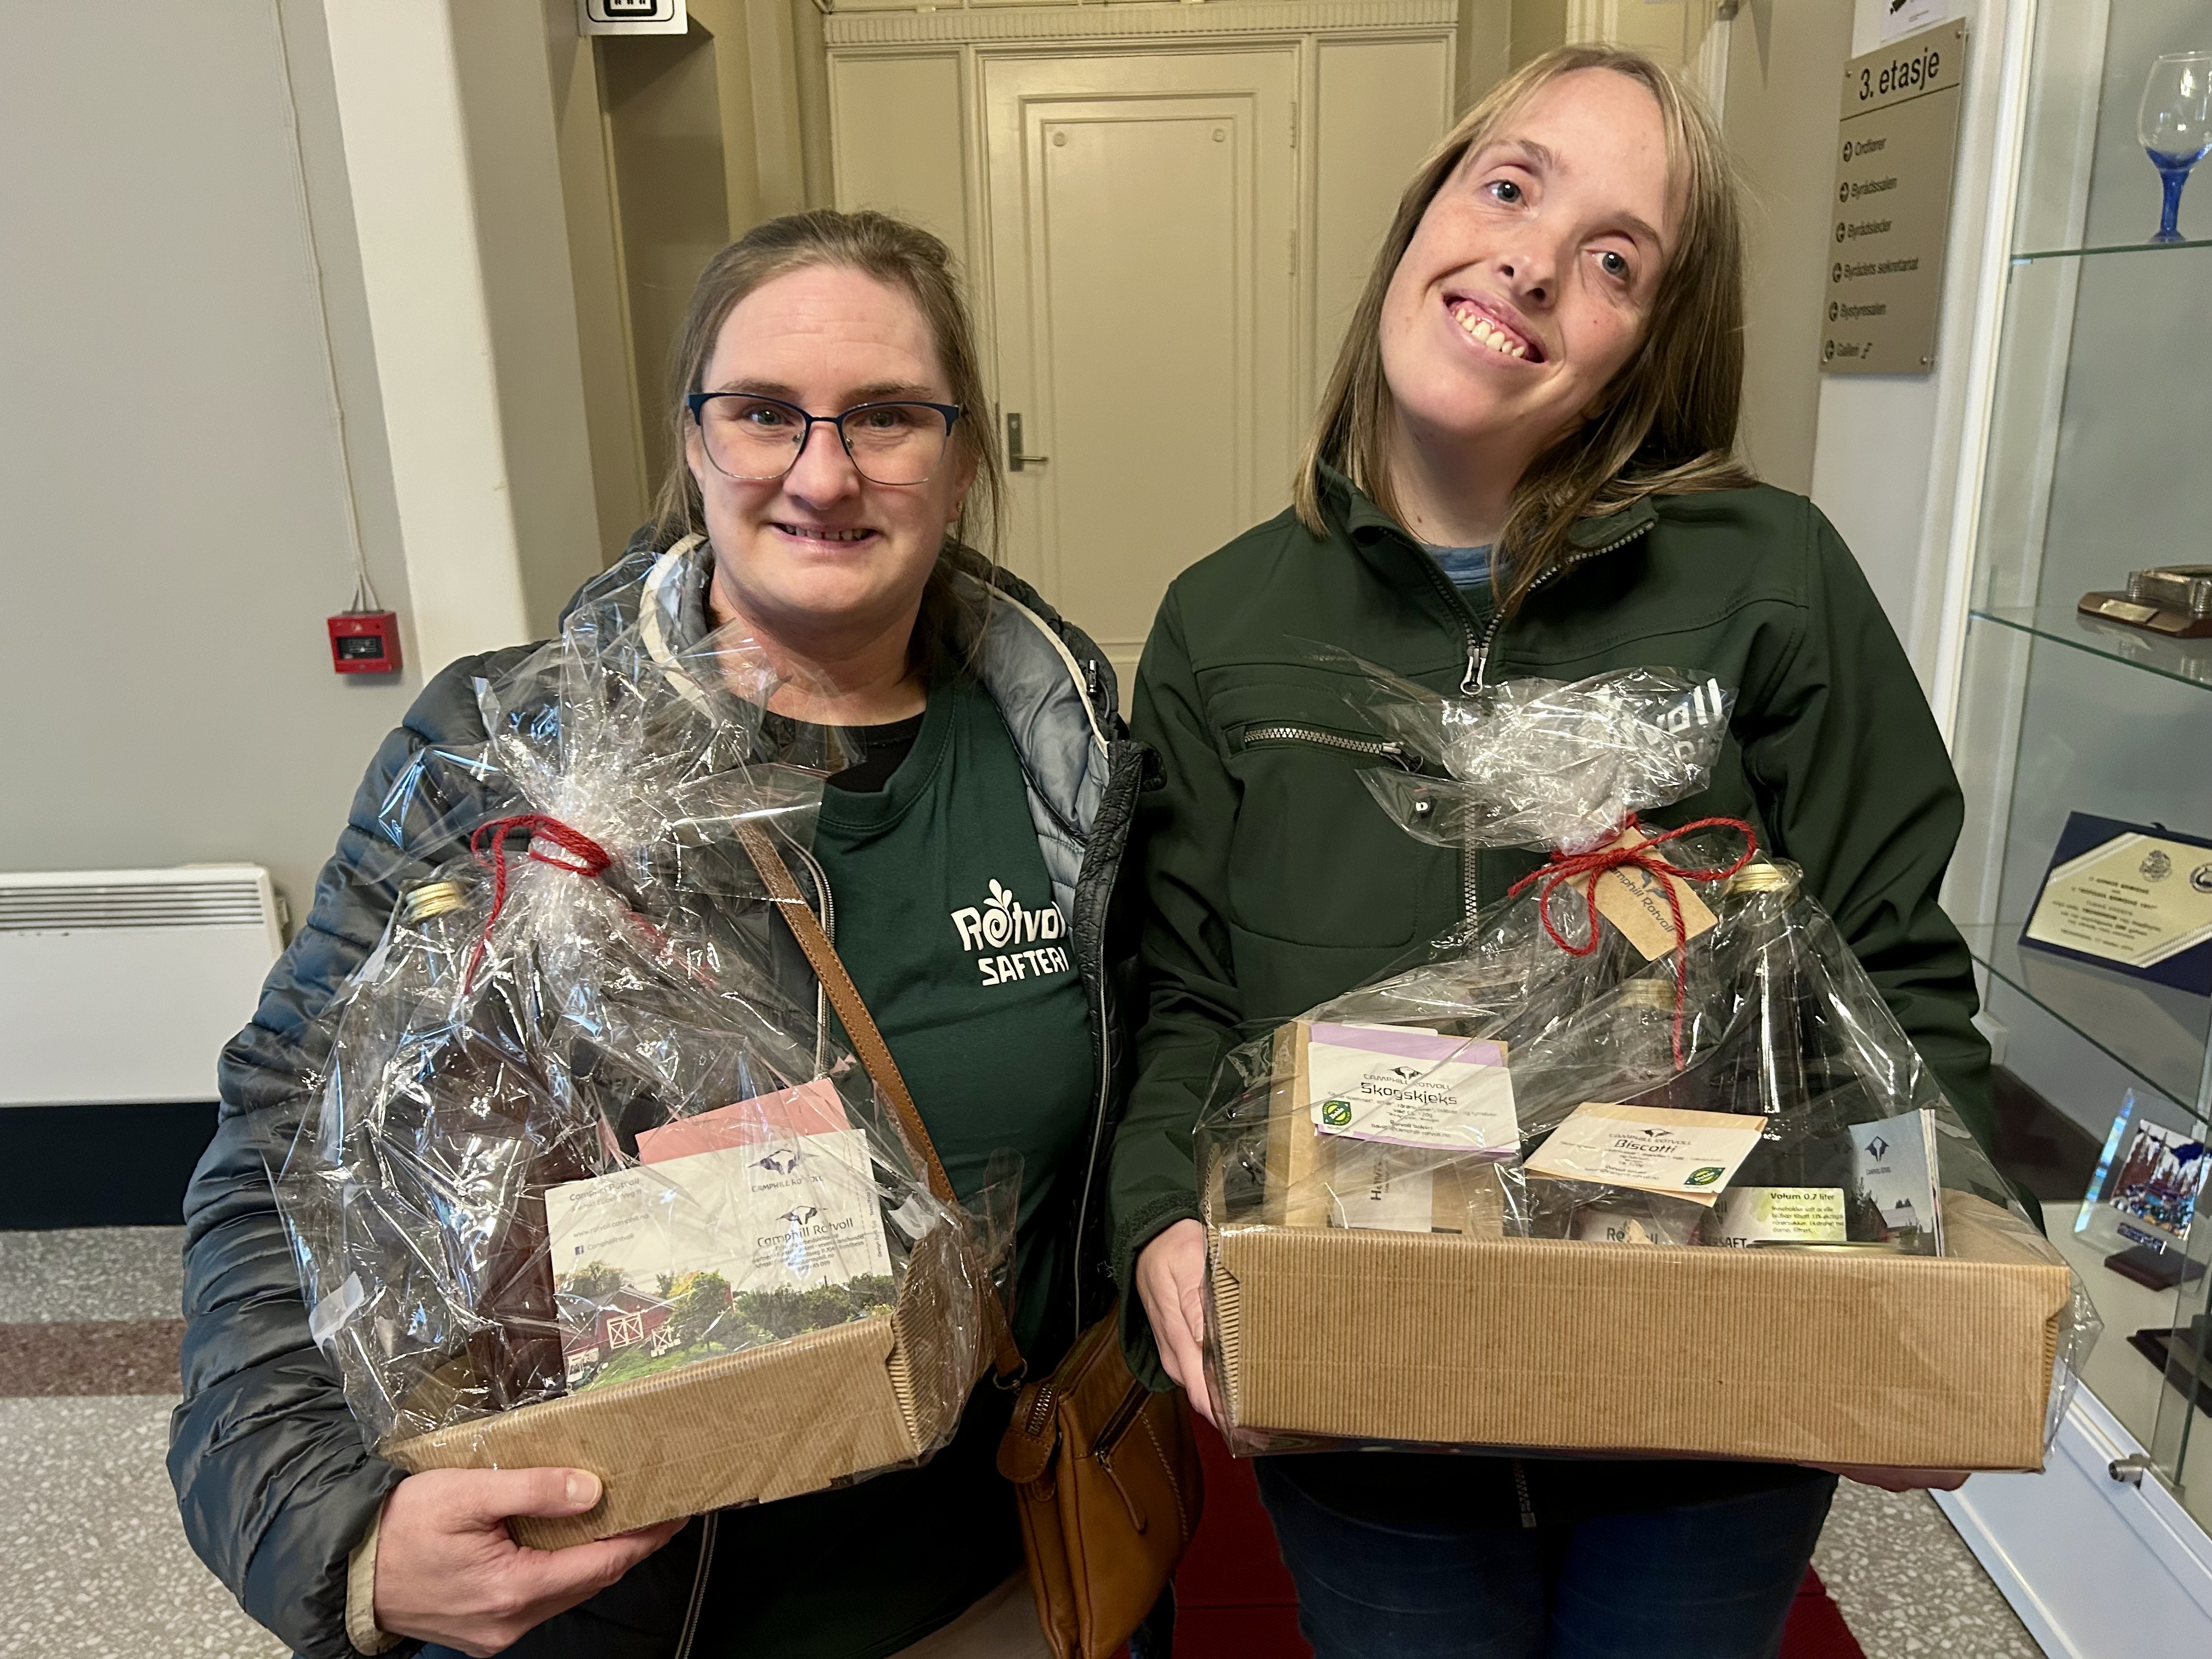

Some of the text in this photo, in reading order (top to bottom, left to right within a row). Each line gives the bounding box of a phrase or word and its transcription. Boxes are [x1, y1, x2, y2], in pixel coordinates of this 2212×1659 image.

[1860, 47, 1939, 100] 3. etasje
[1641, 897, 1675, 933] Rotvoll
[978, 946, 1070, 986] SAFTERI
[1363, 1074, 1409, 1085] CAMPHILL
[1361, 1081, 1458, 1106] Skogskjeks
[1614, 1139, 1678, 1153] Biscotti
[1770, 1192, 1801, 1200] Volum
[758, 1227, 809, 1247] Camphill
